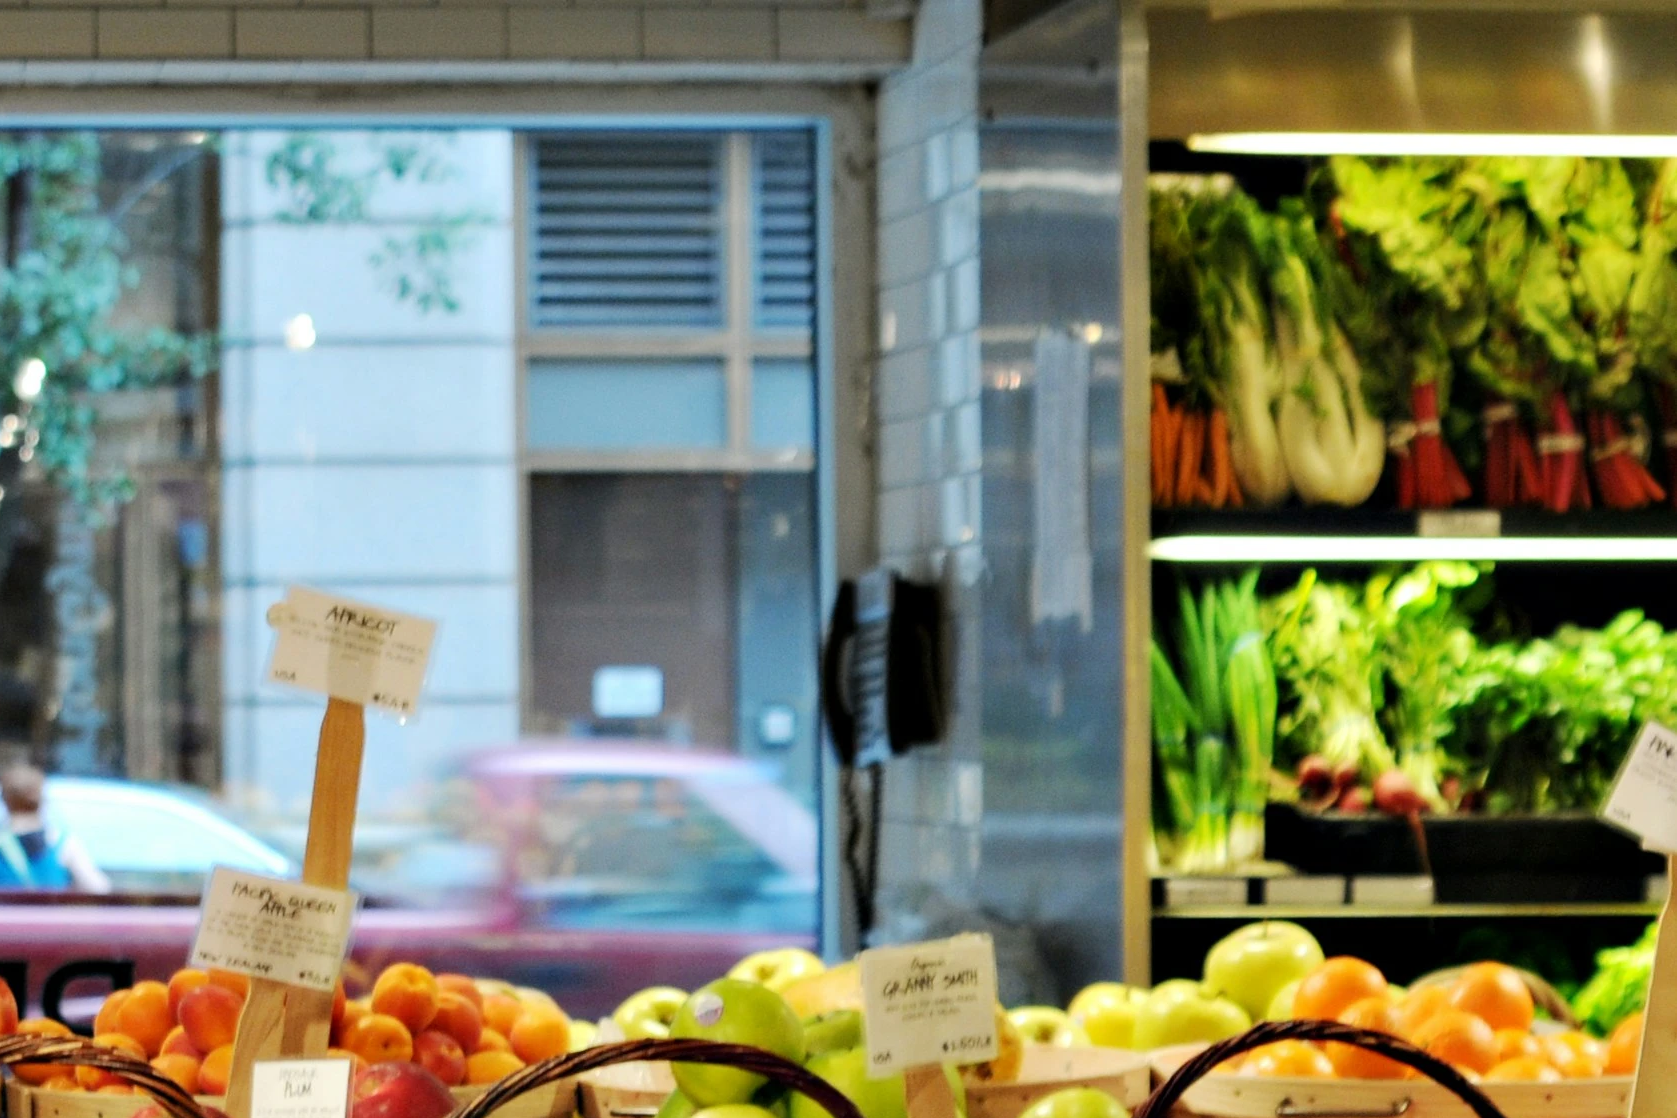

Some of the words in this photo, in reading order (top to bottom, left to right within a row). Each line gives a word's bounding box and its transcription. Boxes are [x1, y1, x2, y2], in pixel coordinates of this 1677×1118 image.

[326, 605, 399, 637] APRICOT
[883, 972, 937, 999] GRANNY
[943, 968, 979, 991] SMITH
